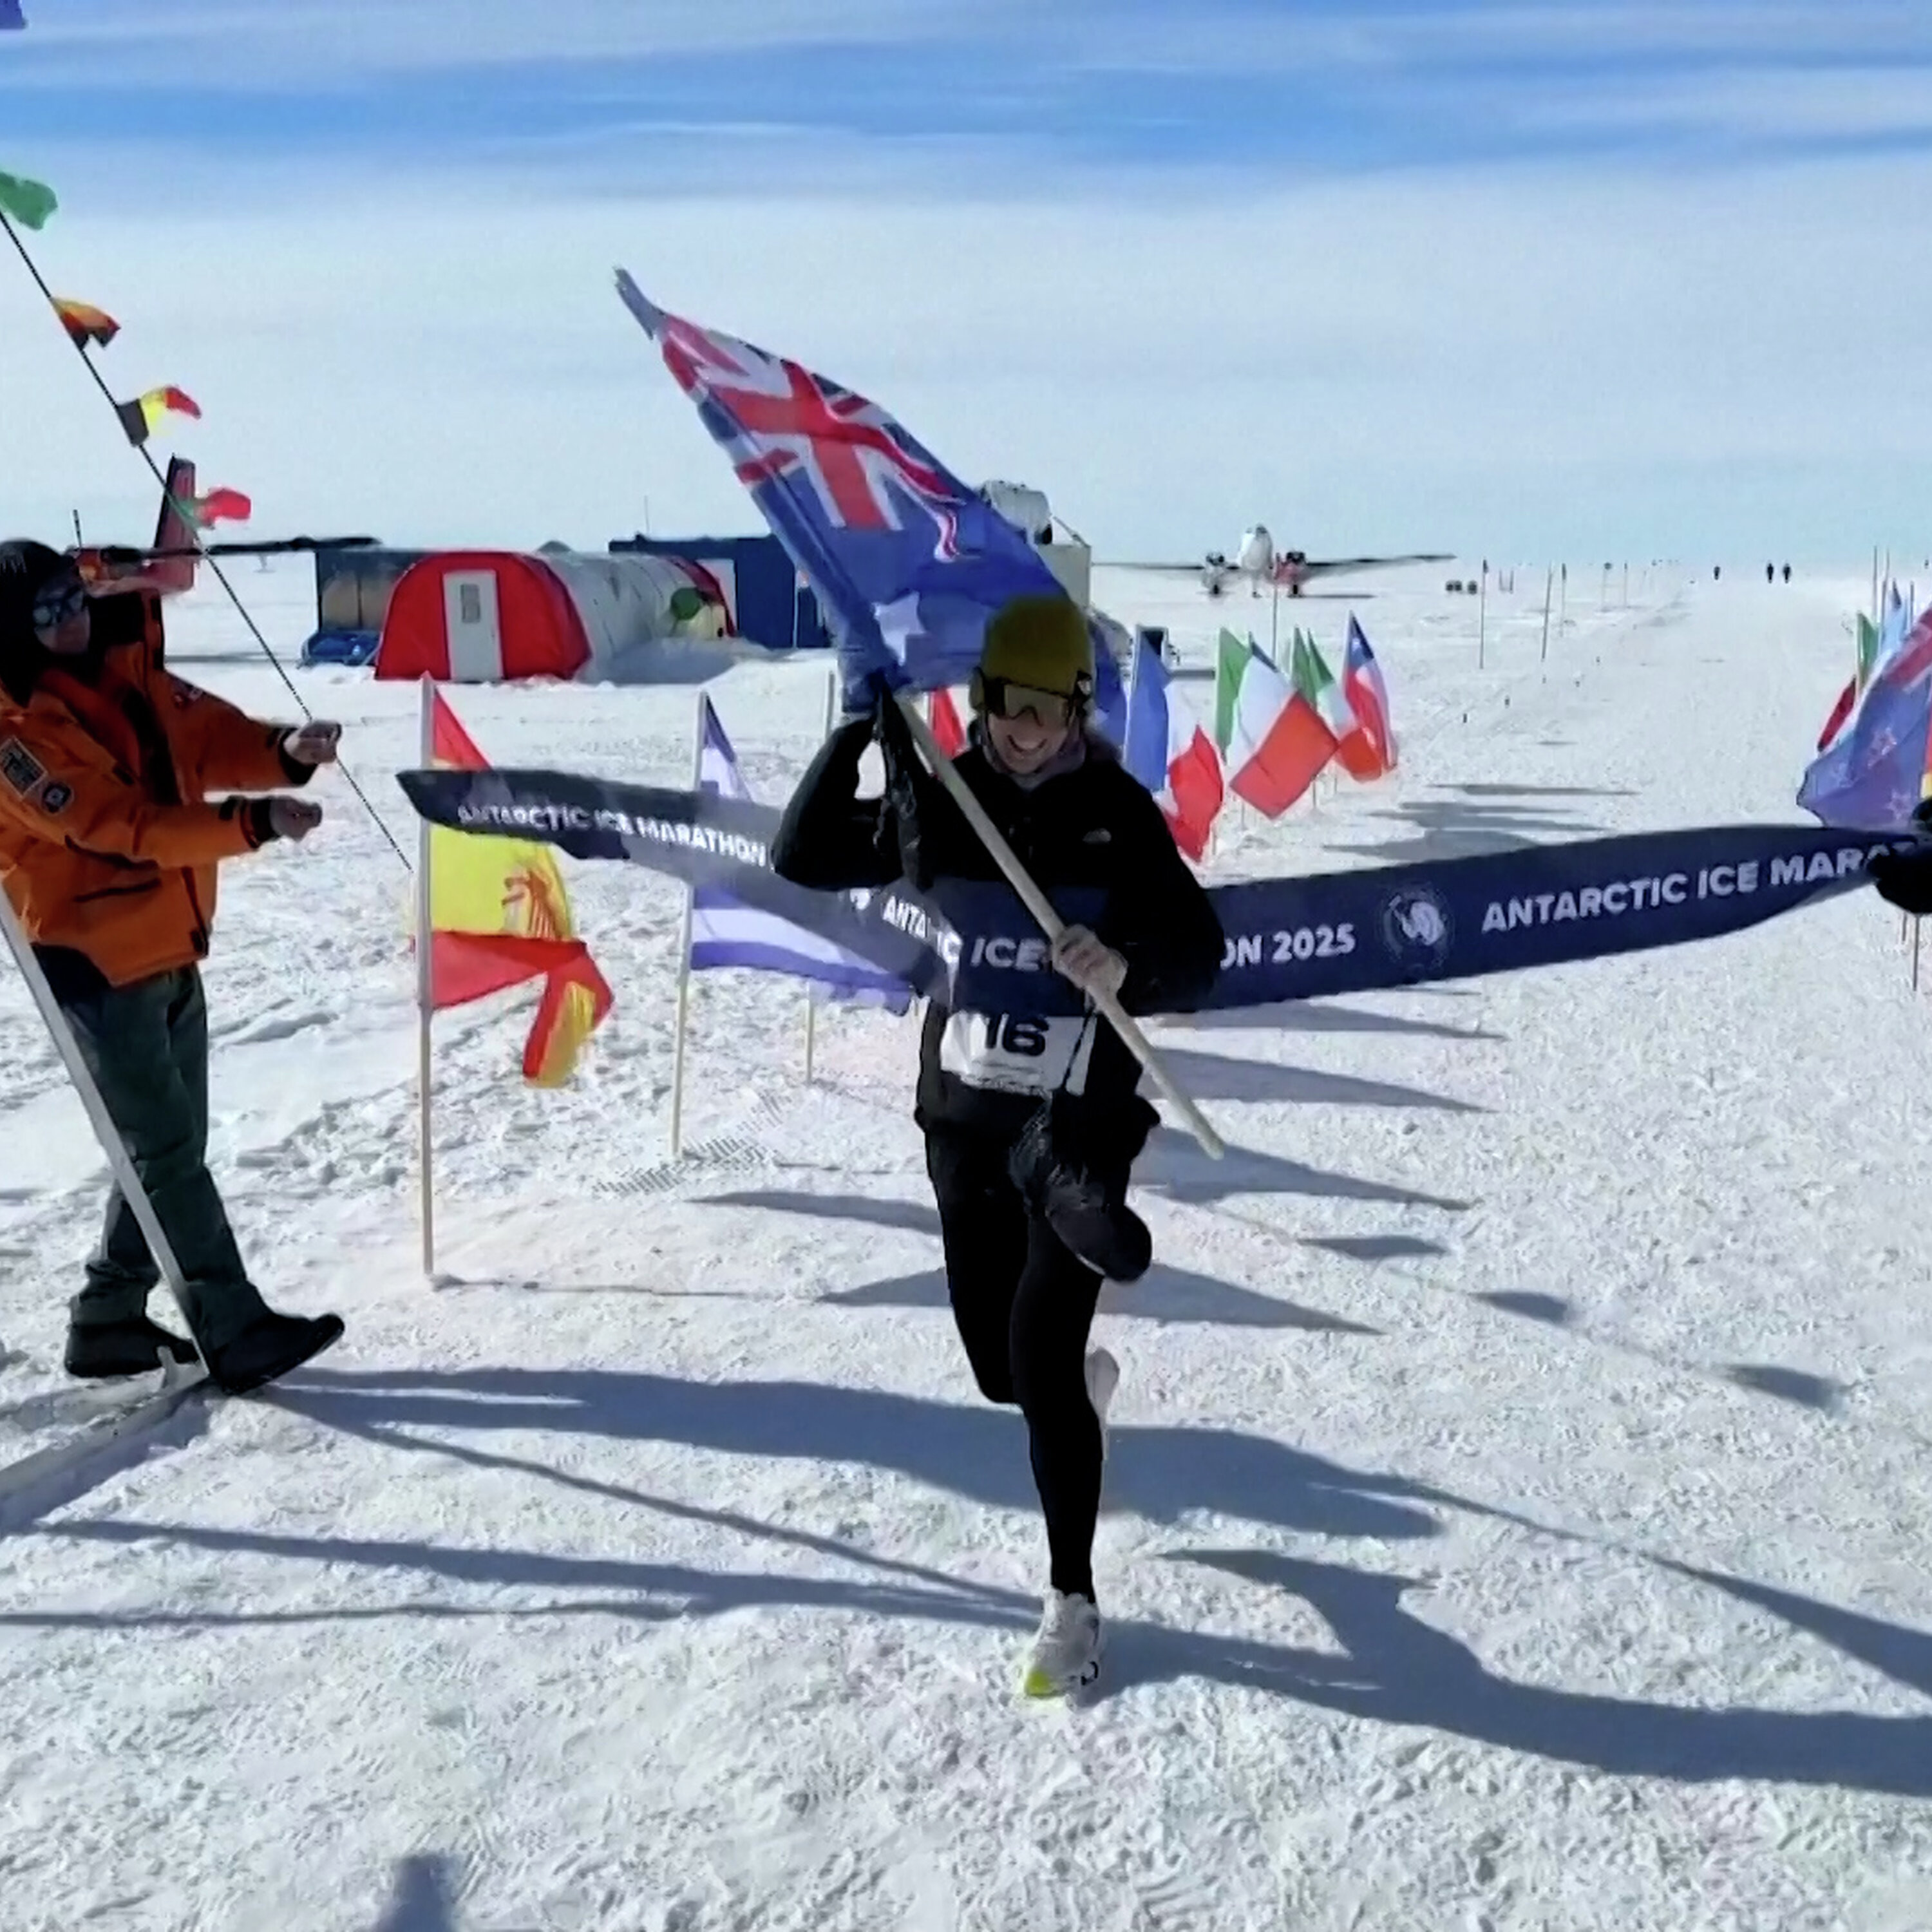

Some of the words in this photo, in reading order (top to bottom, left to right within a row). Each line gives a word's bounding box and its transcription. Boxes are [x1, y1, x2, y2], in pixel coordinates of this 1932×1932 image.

[636, 816, 766, 867] MARATHON
[1481, 873, 1687, 934] ANTARCTIC
[1698, 860, 1759, 900] ICE
[971, 936, 1045, 972] ICE
[1271, 922, 1356, 963] 2025
[985, 1012, 1049, 1057] 16
